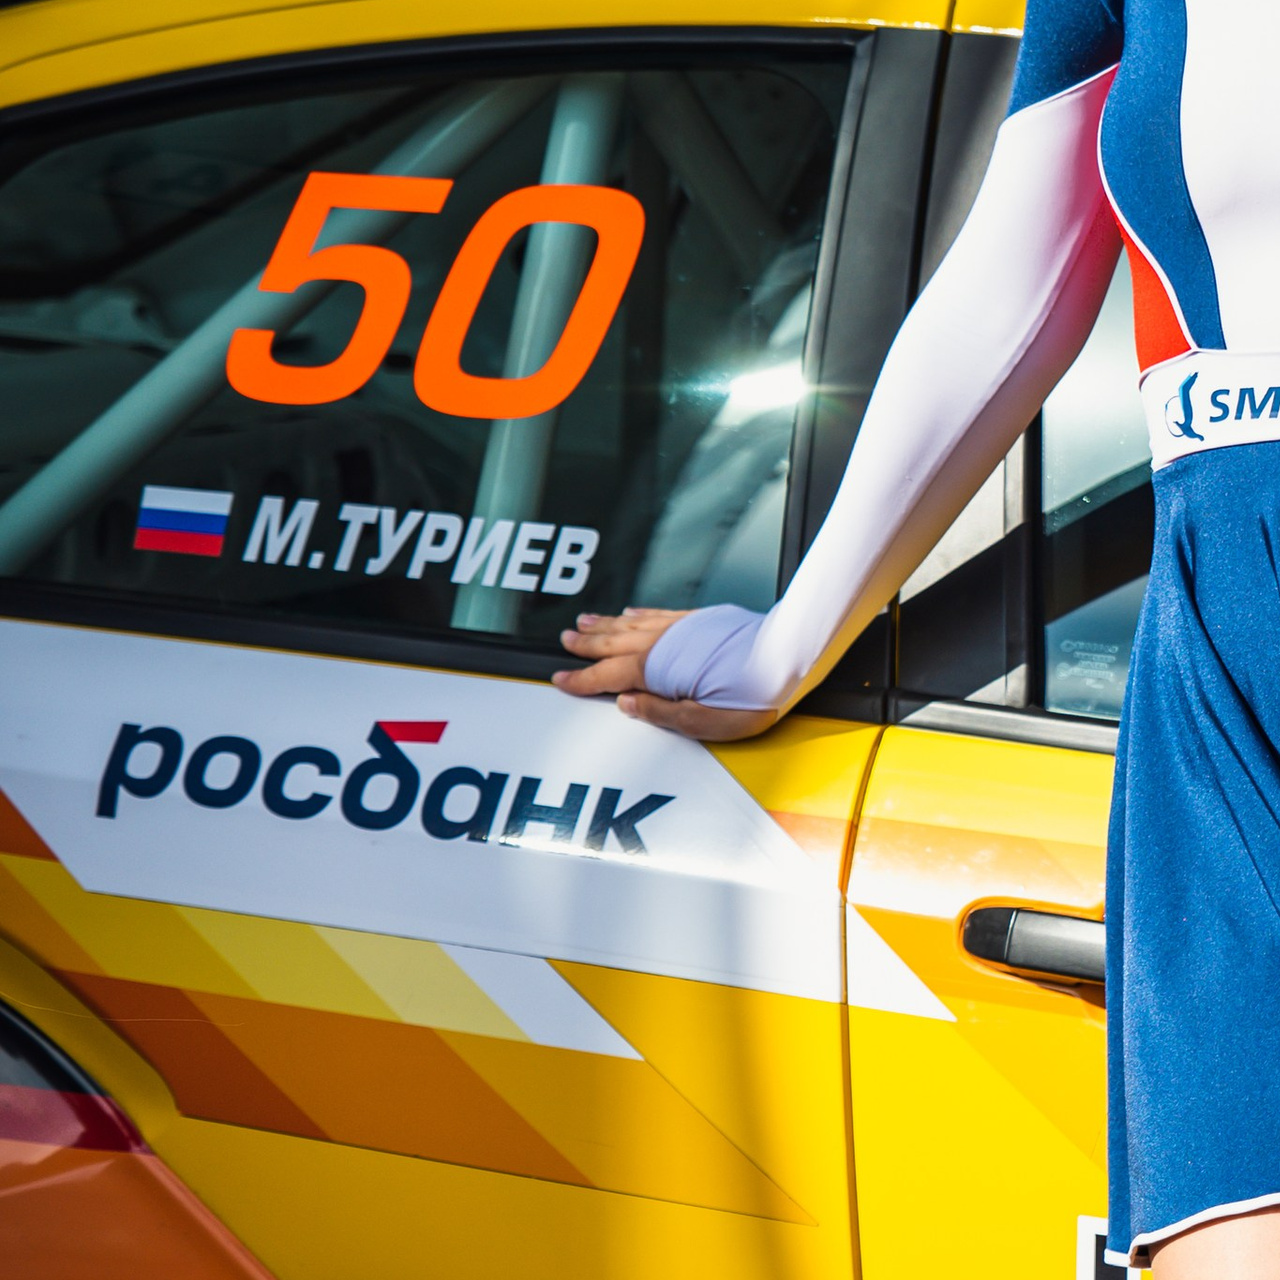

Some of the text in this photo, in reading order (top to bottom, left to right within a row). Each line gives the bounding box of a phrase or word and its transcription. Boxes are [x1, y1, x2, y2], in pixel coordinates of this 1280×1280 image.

[225, 171, 646, 419] 50
[242, 496, 600, 597] М.ТУРИЕВ
[96, 720, 677, 860] росбанк
